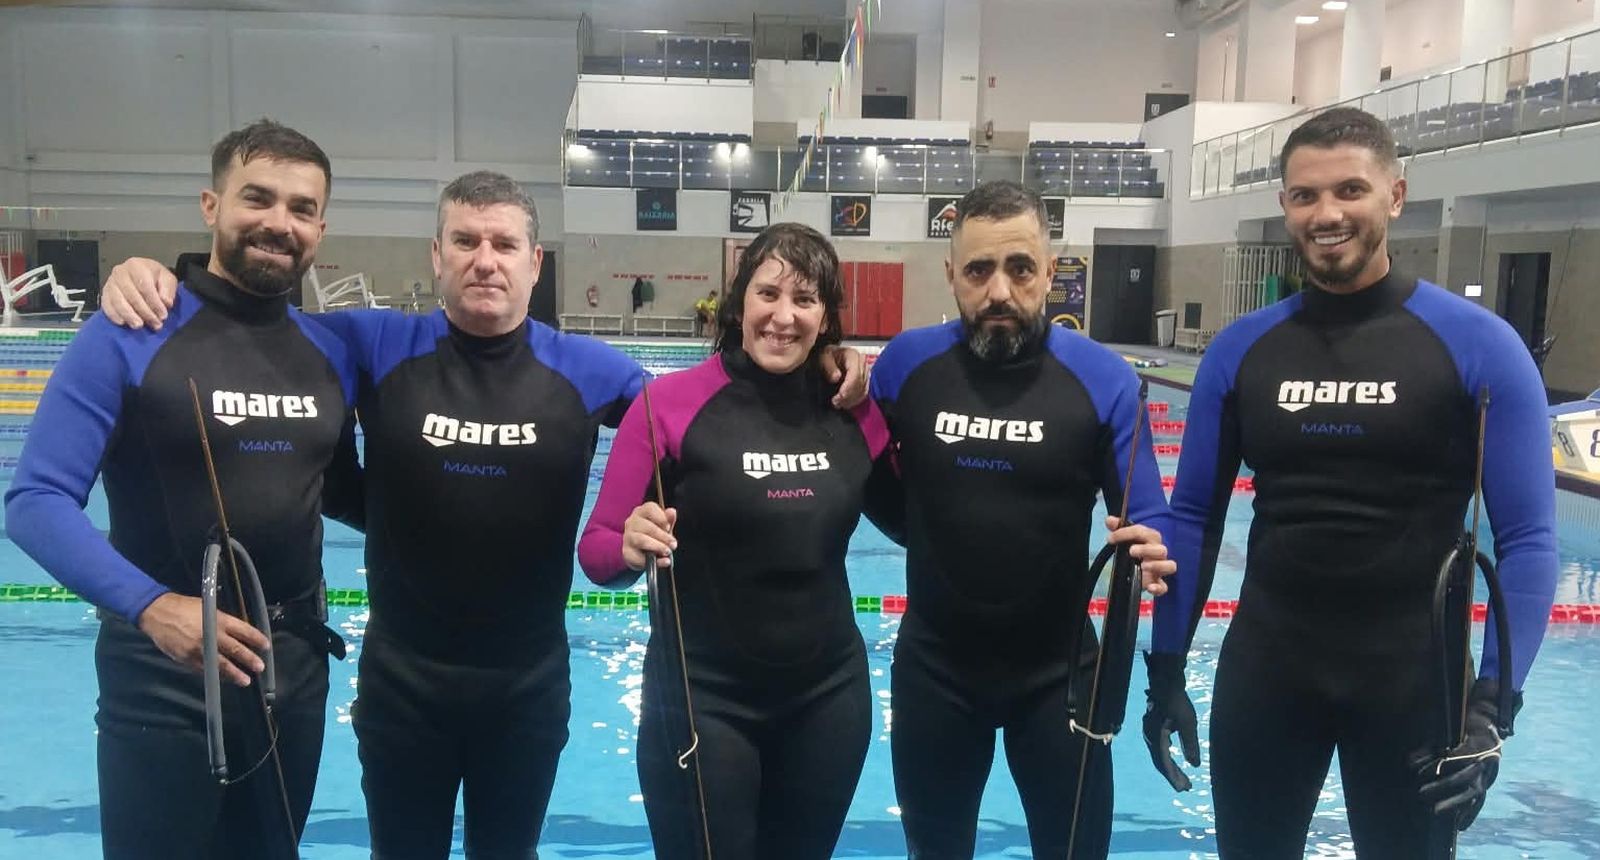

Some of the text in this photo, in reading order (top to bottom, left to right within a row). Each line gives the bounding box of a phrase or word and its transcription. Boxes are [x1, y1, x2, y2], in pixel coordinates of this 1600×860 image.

[212, 390, 318, 426] mares
[1278, 381, 1397, 412] mares
[422, 413, 537, 447] mares
[935, 411, 1044, 443] mares
[1301, 423, 1364, 436] MANTA
[239, 439, 295, 453] MANTA
[444, 460, 507, 477] MANTA
[742, 451, 829, 480] mares
[956, 455, 1014, 471] MANTA
[766, 488, 815, 499] MANTA
